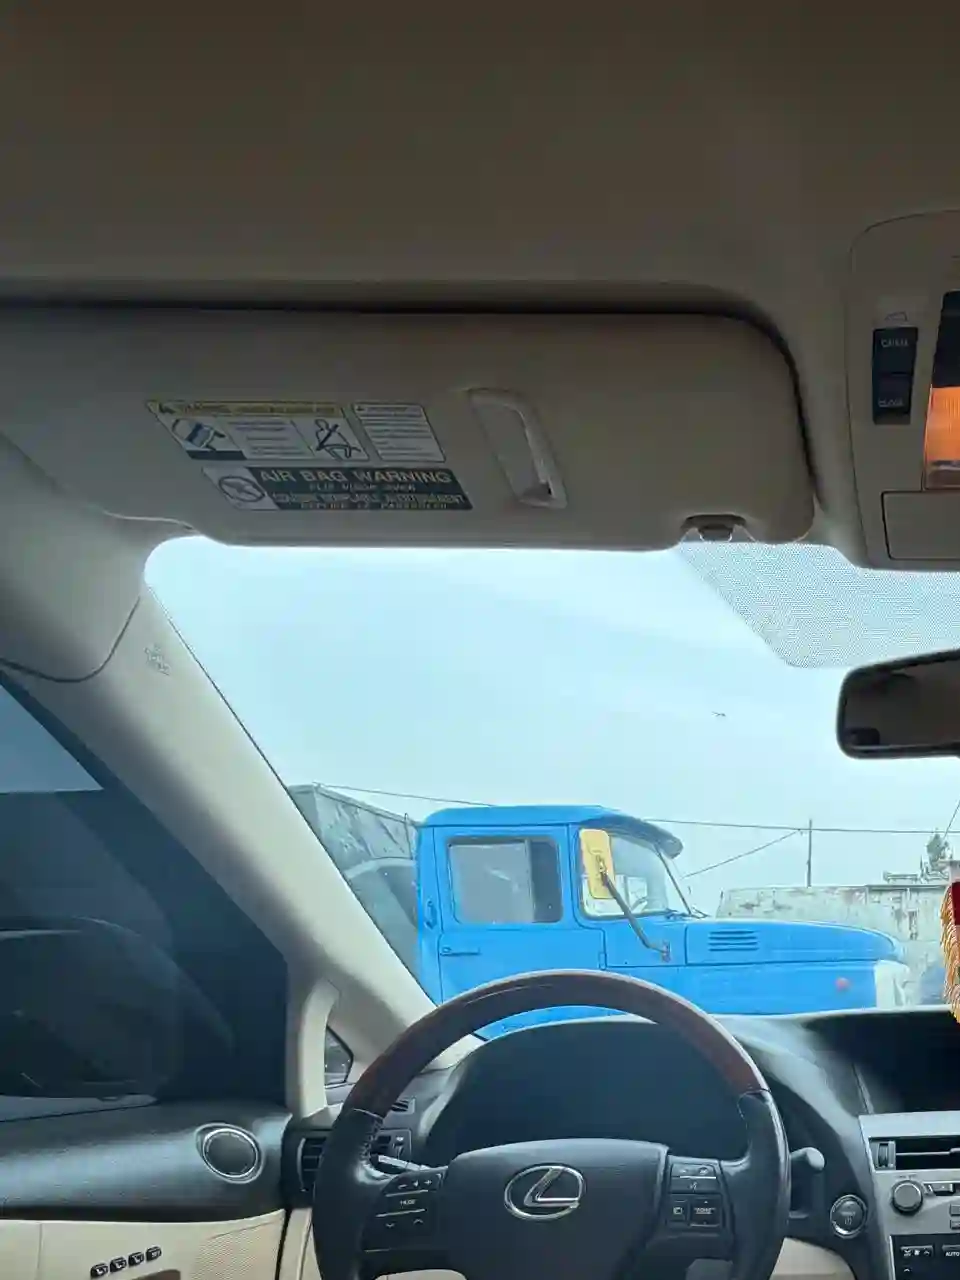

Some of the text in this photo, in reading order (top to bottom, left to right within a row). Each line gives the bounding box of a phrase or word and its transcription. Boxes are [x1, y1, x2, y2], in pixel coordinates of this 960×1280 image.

[260, 469, 452, 483] AIR BAG WARNING
